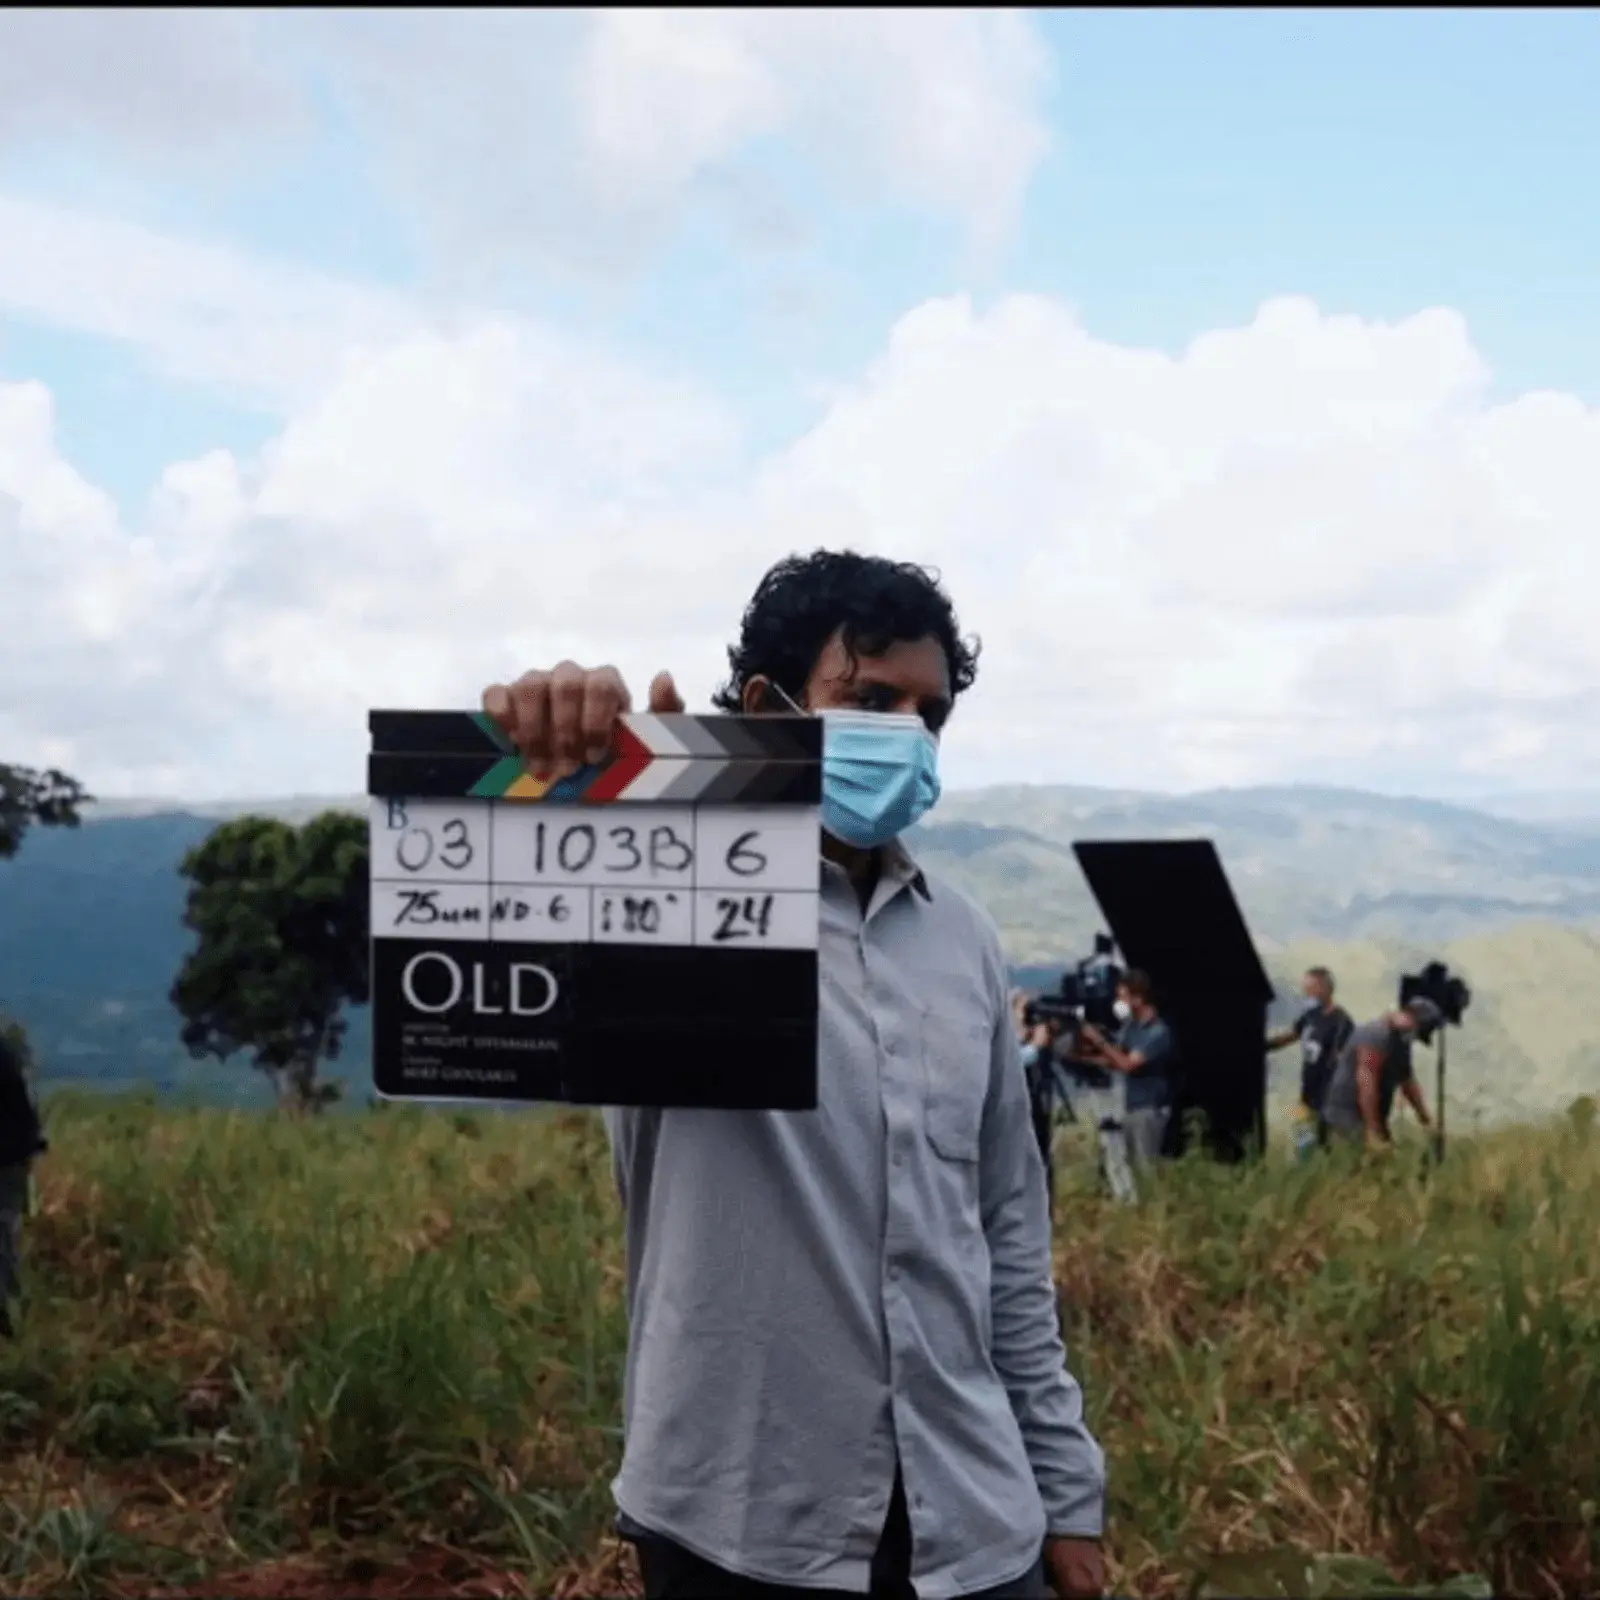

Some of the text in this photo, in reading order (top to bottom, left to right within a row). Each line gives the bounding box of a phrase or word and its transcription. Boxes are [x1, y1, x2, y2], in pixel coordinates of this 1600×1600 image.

[388, 799, 409, 830] B
[397, 818, 473, 871] 03
[534, 822, 693, 877] 103B
[726, 830, 767, 876] 6
[712, 894, 775, 940] 24
[402, 951, 559, 1016] OLD
